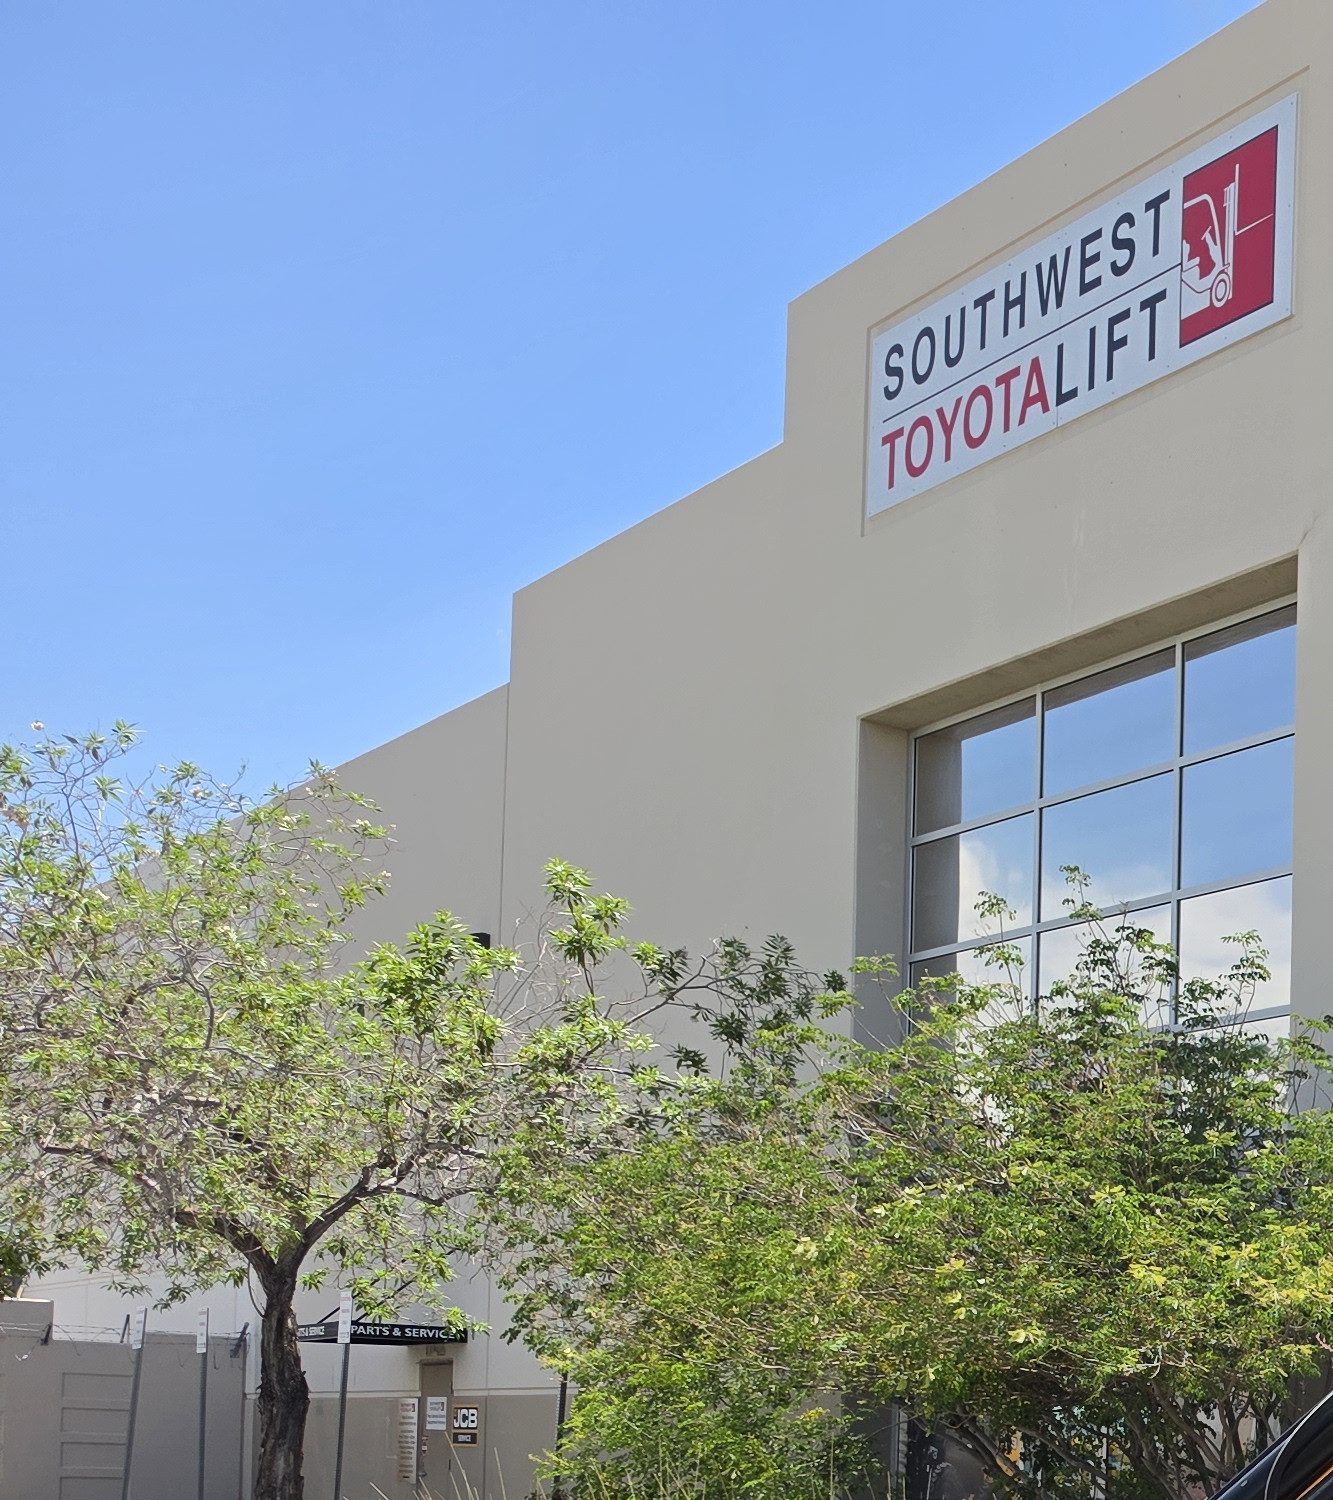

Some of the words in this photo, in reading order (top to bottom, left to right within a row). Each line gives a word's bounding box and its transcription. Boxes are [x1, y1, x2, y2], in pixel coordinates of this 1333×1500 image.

[883, 189, 1171, 401] SOUTHWEST
[350, 1325, 390, 1337] PARTS
[391, 1327, 402, 1337] &
[453, 1408, 478, 1428] JCB
